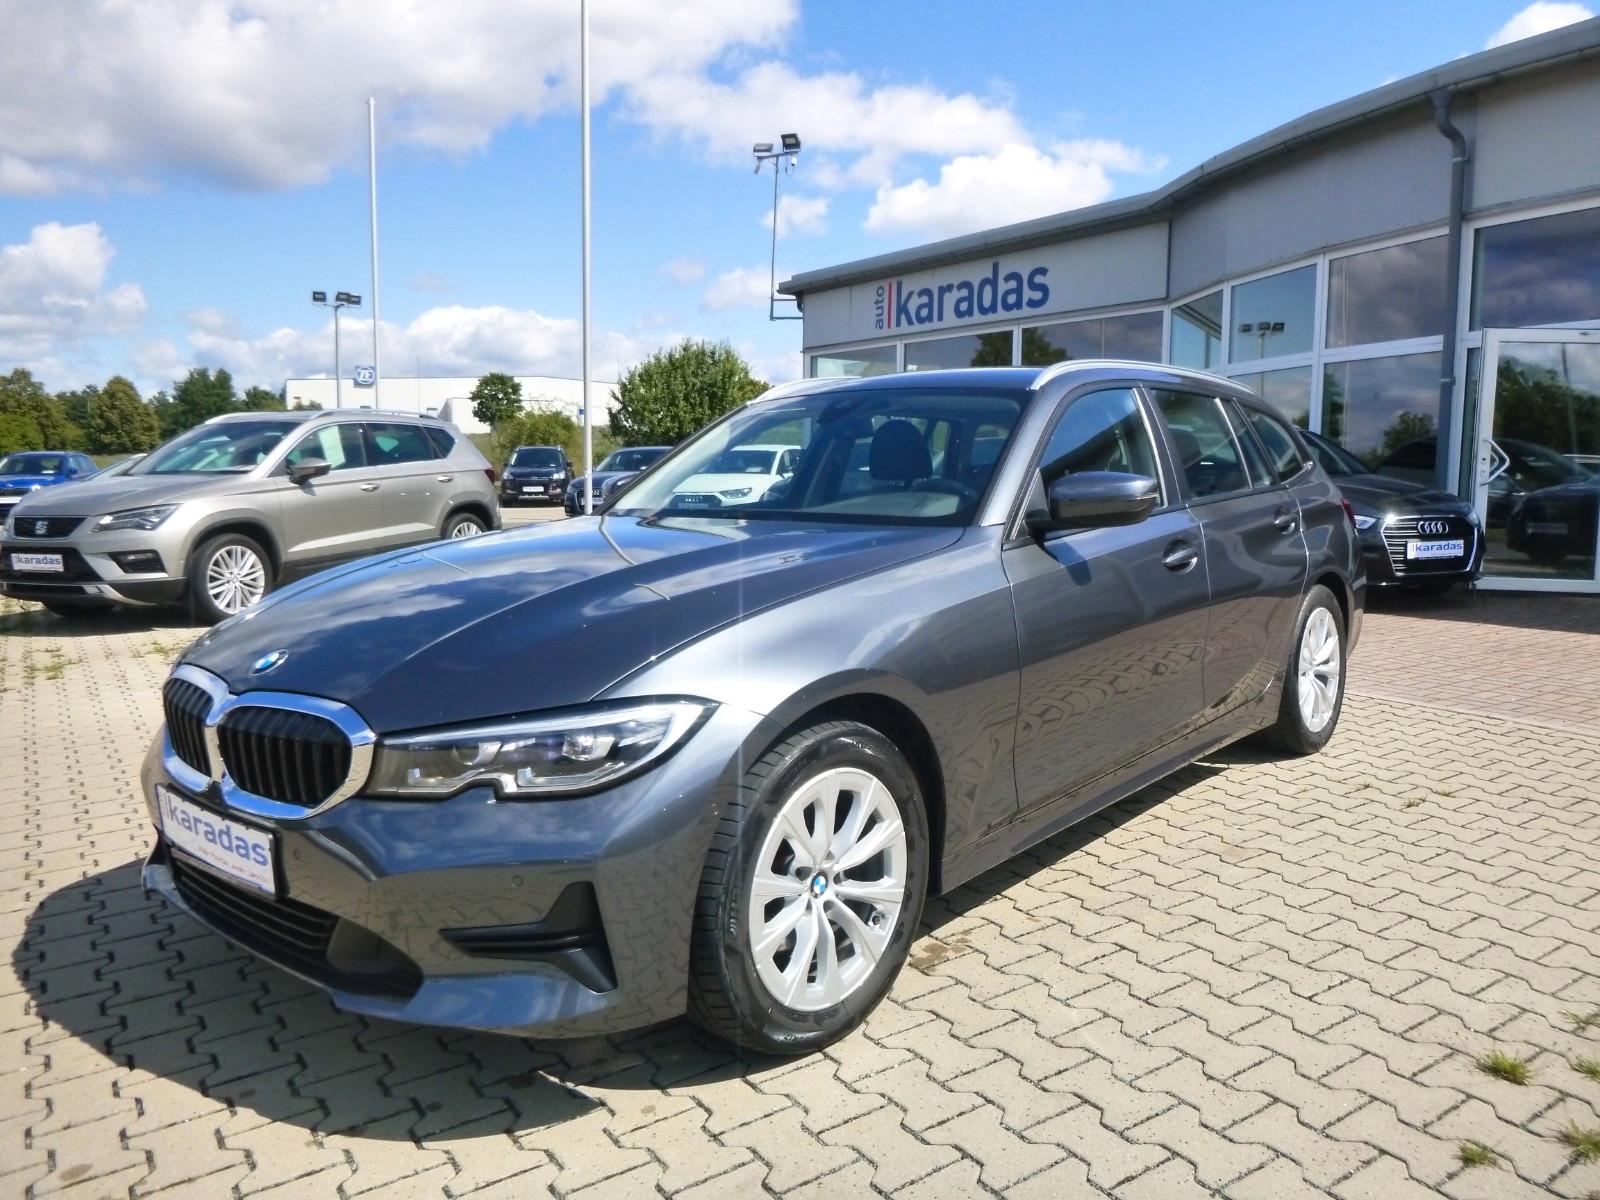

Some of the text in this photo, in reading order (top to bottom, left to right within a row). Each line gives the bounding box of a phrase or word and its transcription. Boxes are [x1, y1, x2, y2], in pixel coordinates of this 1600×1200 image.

[874, 262, 1050, 330] auto karadas
[17, 555, 61, 565] karadas
[1415, 542, 1463, 552] karadas
[168, 794, 269, 867] karadas
